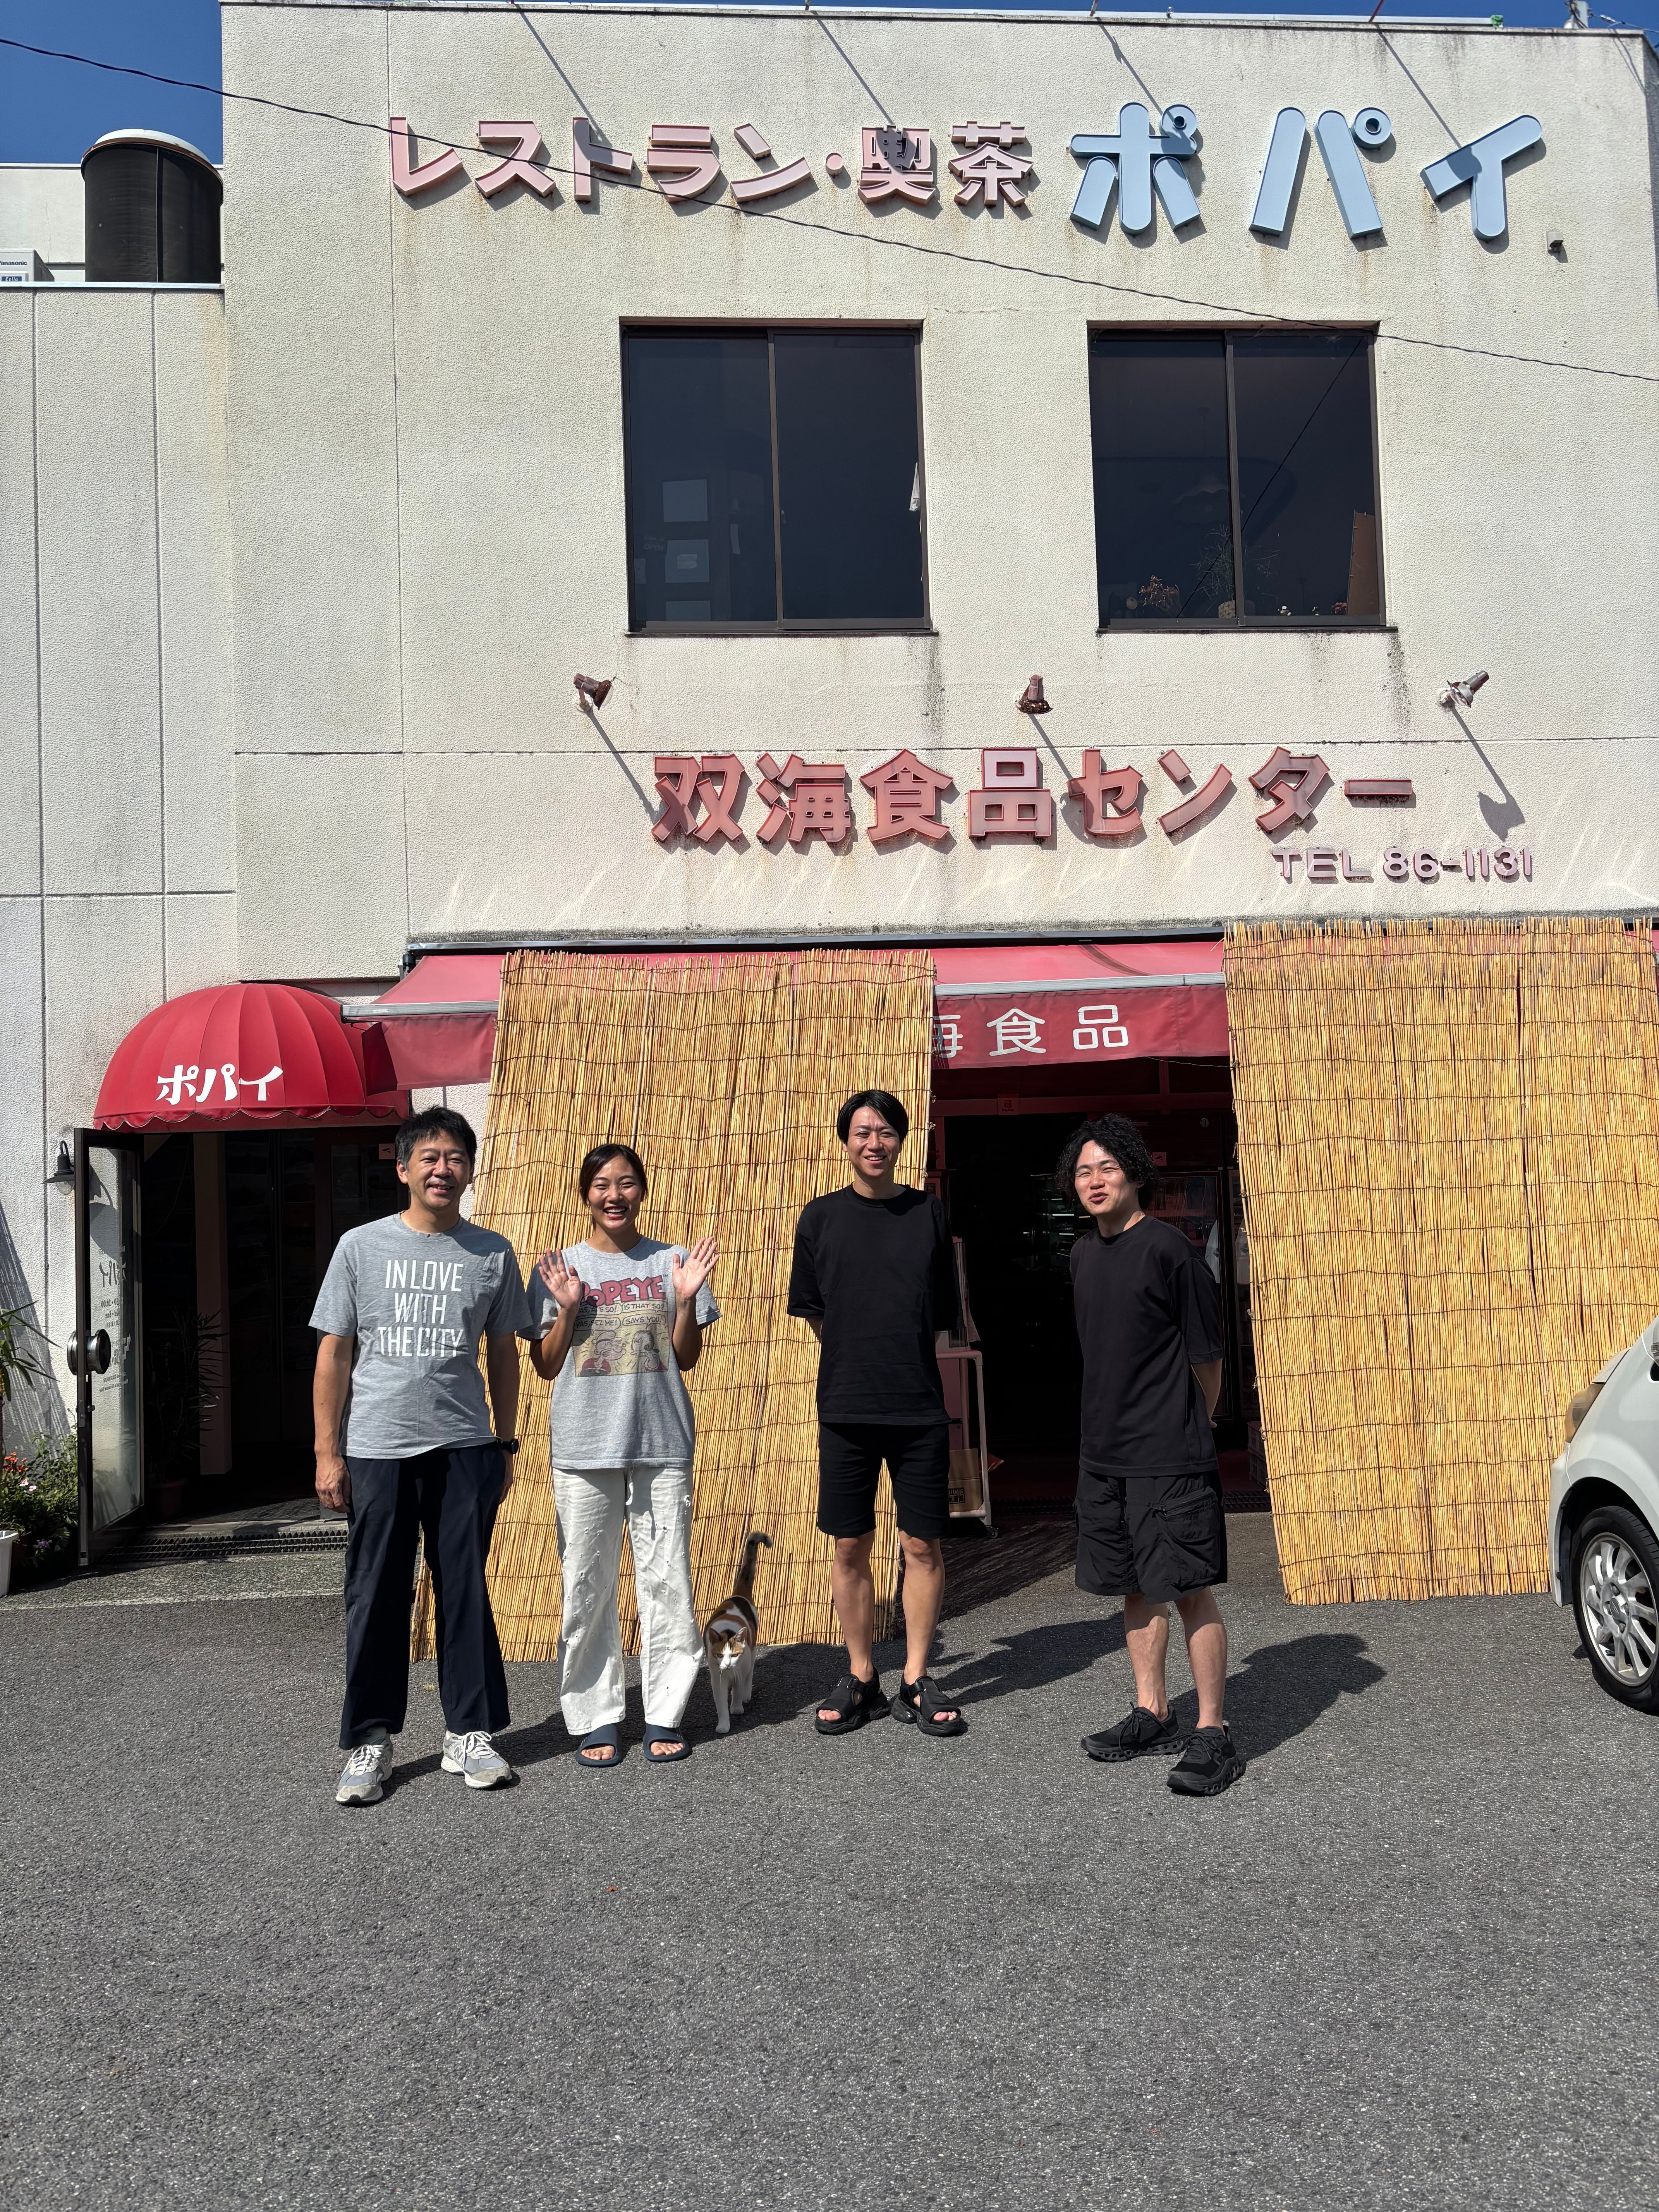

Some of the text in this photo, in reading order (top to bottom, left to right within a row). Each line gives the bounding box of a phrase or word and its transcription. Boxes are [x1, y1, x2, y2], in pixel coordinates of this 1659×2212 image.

[1068, 101, 1543, 239] ポパイ
[651, 747, 1413, 843] 双海食品センター
[1272, 847, 1531, 878] TEL 86-1131
[156, 1063, 283, 1105] ポパイ
[394, 1292, 447, 1324] WITH
[605, 1305, 617, 1313] SO!
[377, 1326, 464, 1357] THE CITY
